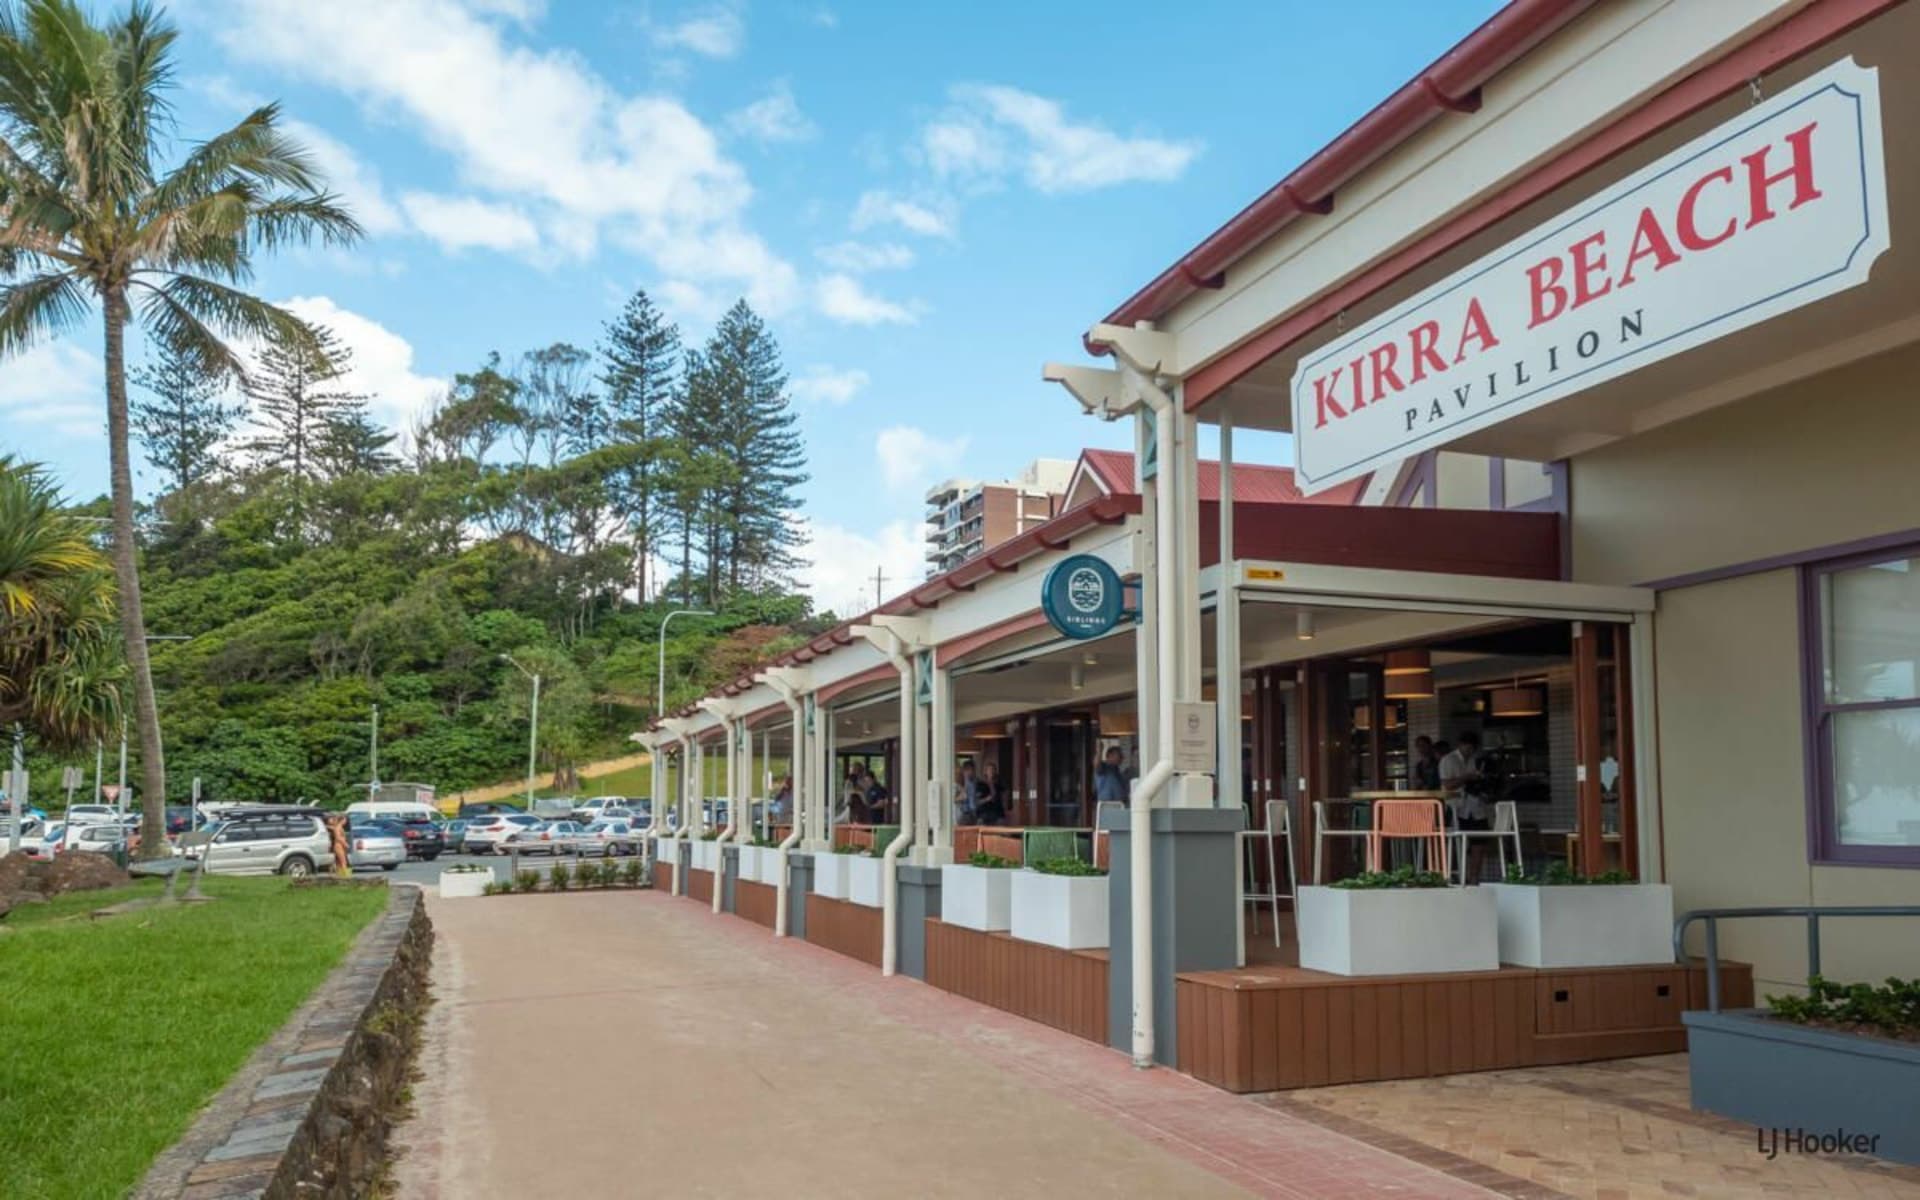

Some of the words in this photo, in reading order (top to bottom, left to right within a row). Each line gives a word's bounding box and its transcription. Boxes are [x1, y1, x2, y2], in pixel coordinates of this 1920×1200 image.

[1312, 297, 1500, 429] KIRRA
[1525, 121, 1822, 330] BEACH
[1405, 309, 1643, 431] PAVILION
